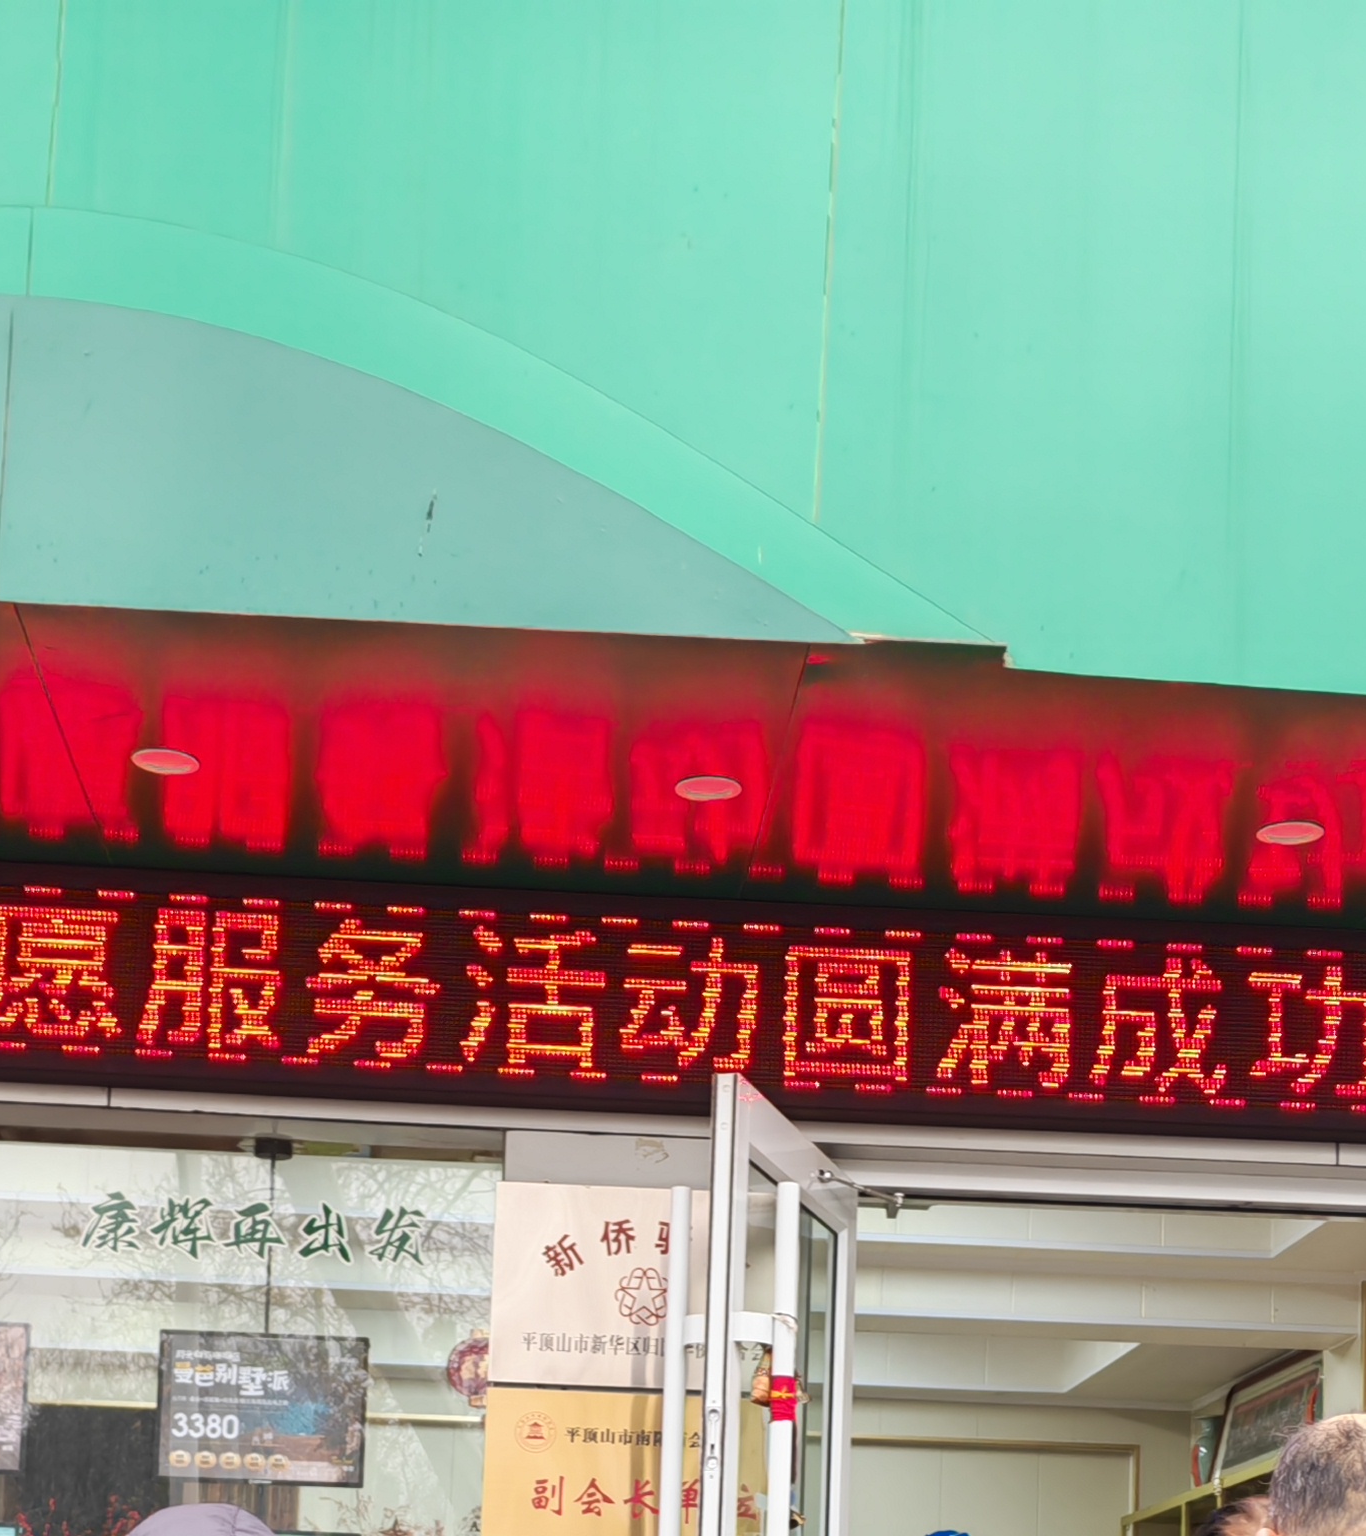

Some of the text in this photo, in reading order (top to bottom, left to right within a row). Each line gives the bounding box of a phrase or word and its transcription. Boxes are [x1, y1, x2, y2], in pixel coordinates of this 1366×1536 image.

[81, 1190, 428, 1267] 康辉再出发
[171, 1412, 240, 1440] 3380
